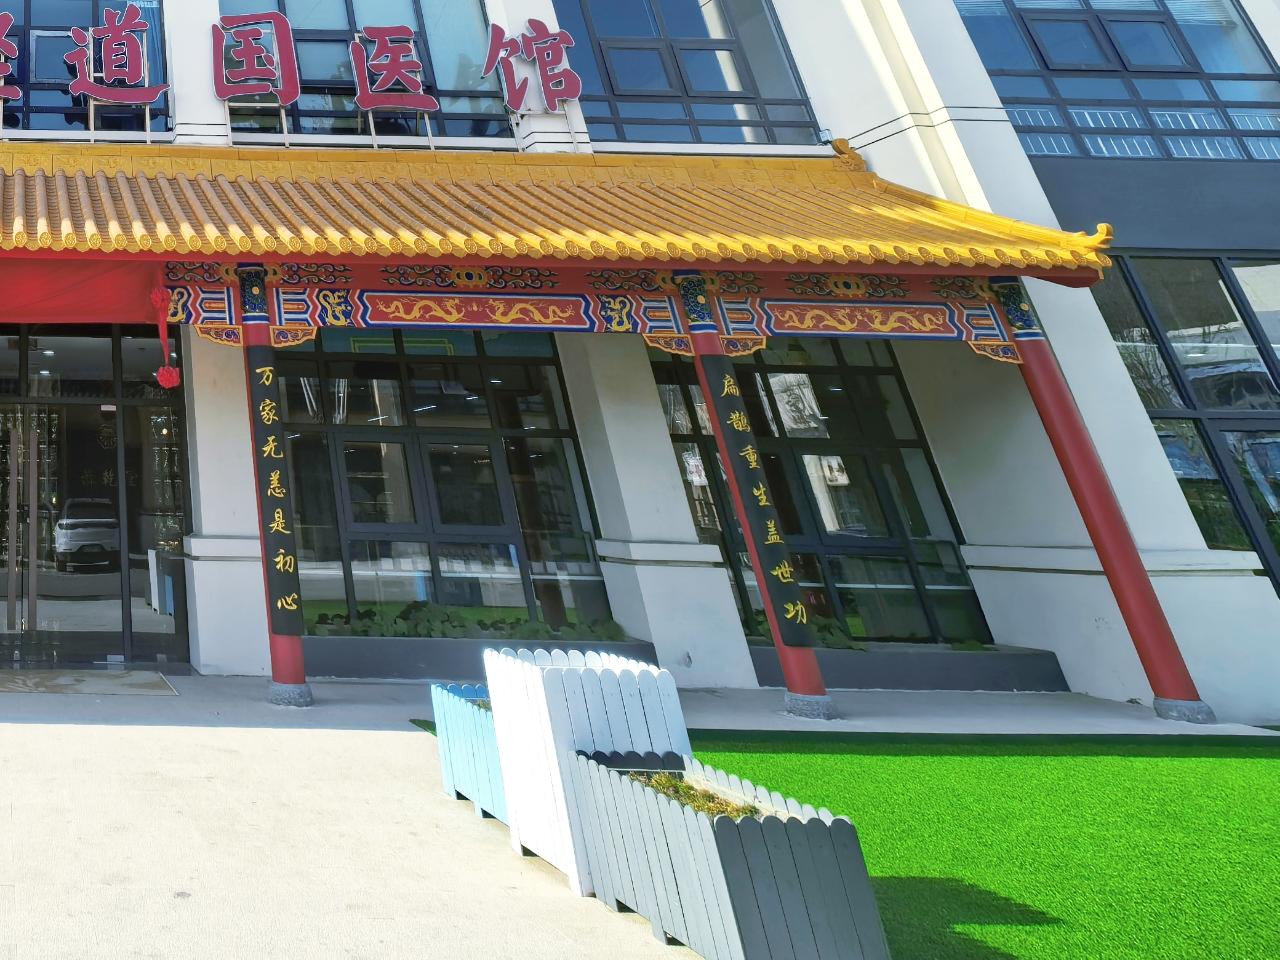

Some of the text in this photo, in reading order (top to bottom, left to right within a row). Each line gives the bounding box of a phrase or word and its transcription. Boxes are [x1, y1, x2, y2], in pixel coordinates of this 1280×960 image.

[255, 366, 299, 612] 万家无恙是初心
